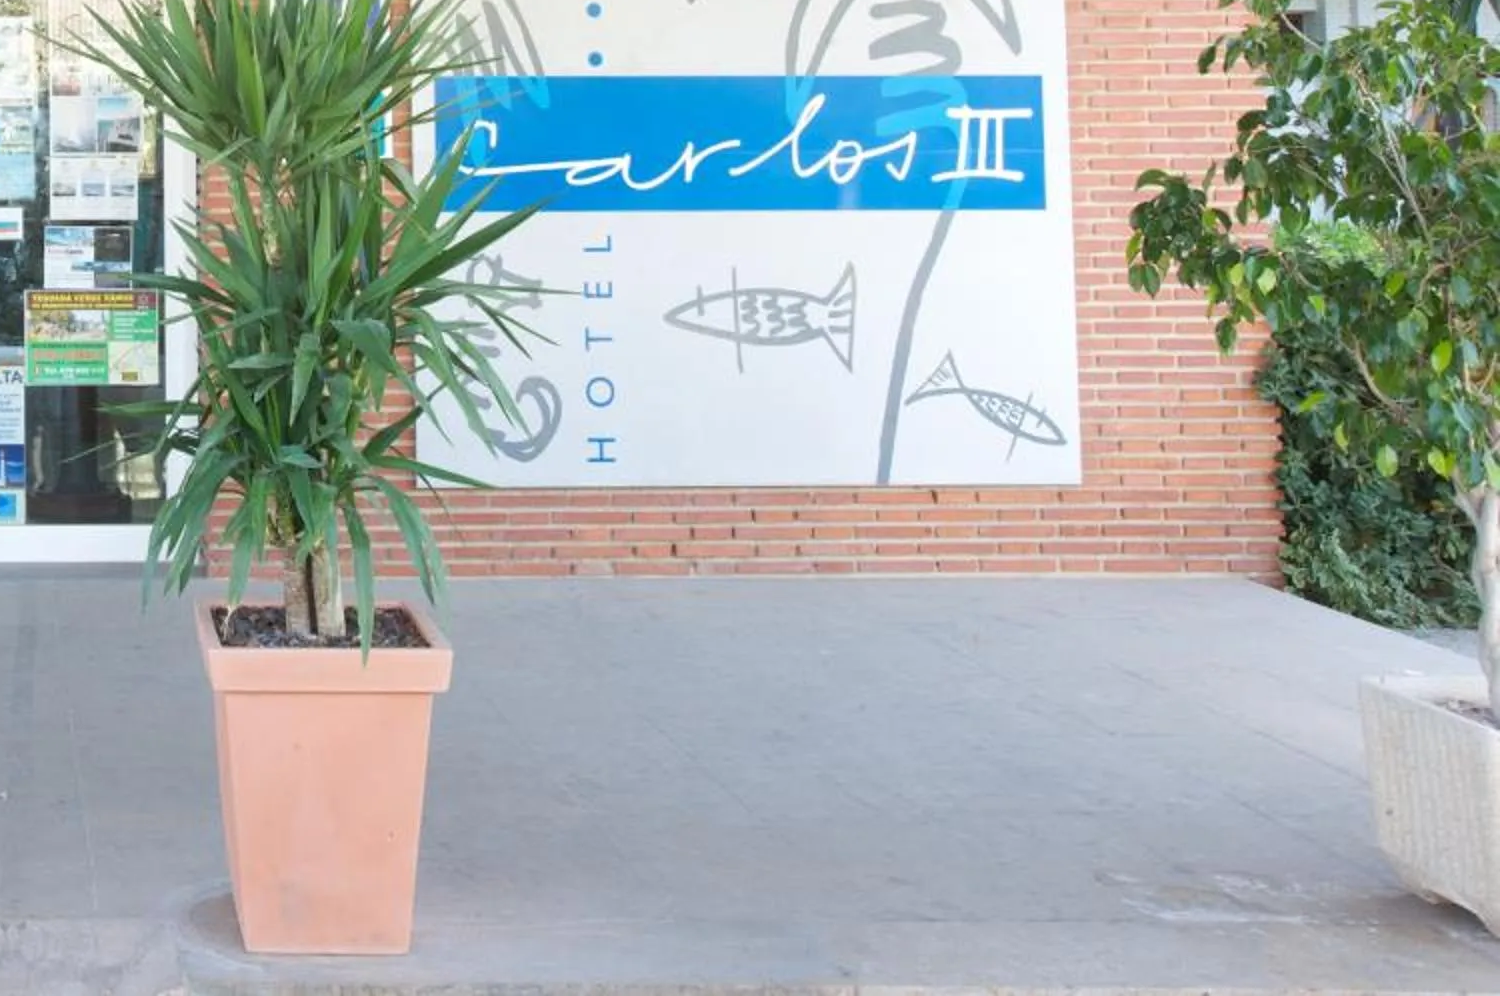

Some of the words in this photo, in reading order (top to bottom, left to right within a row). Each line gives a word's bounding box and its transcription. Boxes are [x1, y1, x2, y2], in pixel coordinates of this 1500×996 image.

[452, 92, 917, 191] Carlos
[930, 104, 1034, 183] III
[582, 234, 617, 464] HOTEL
